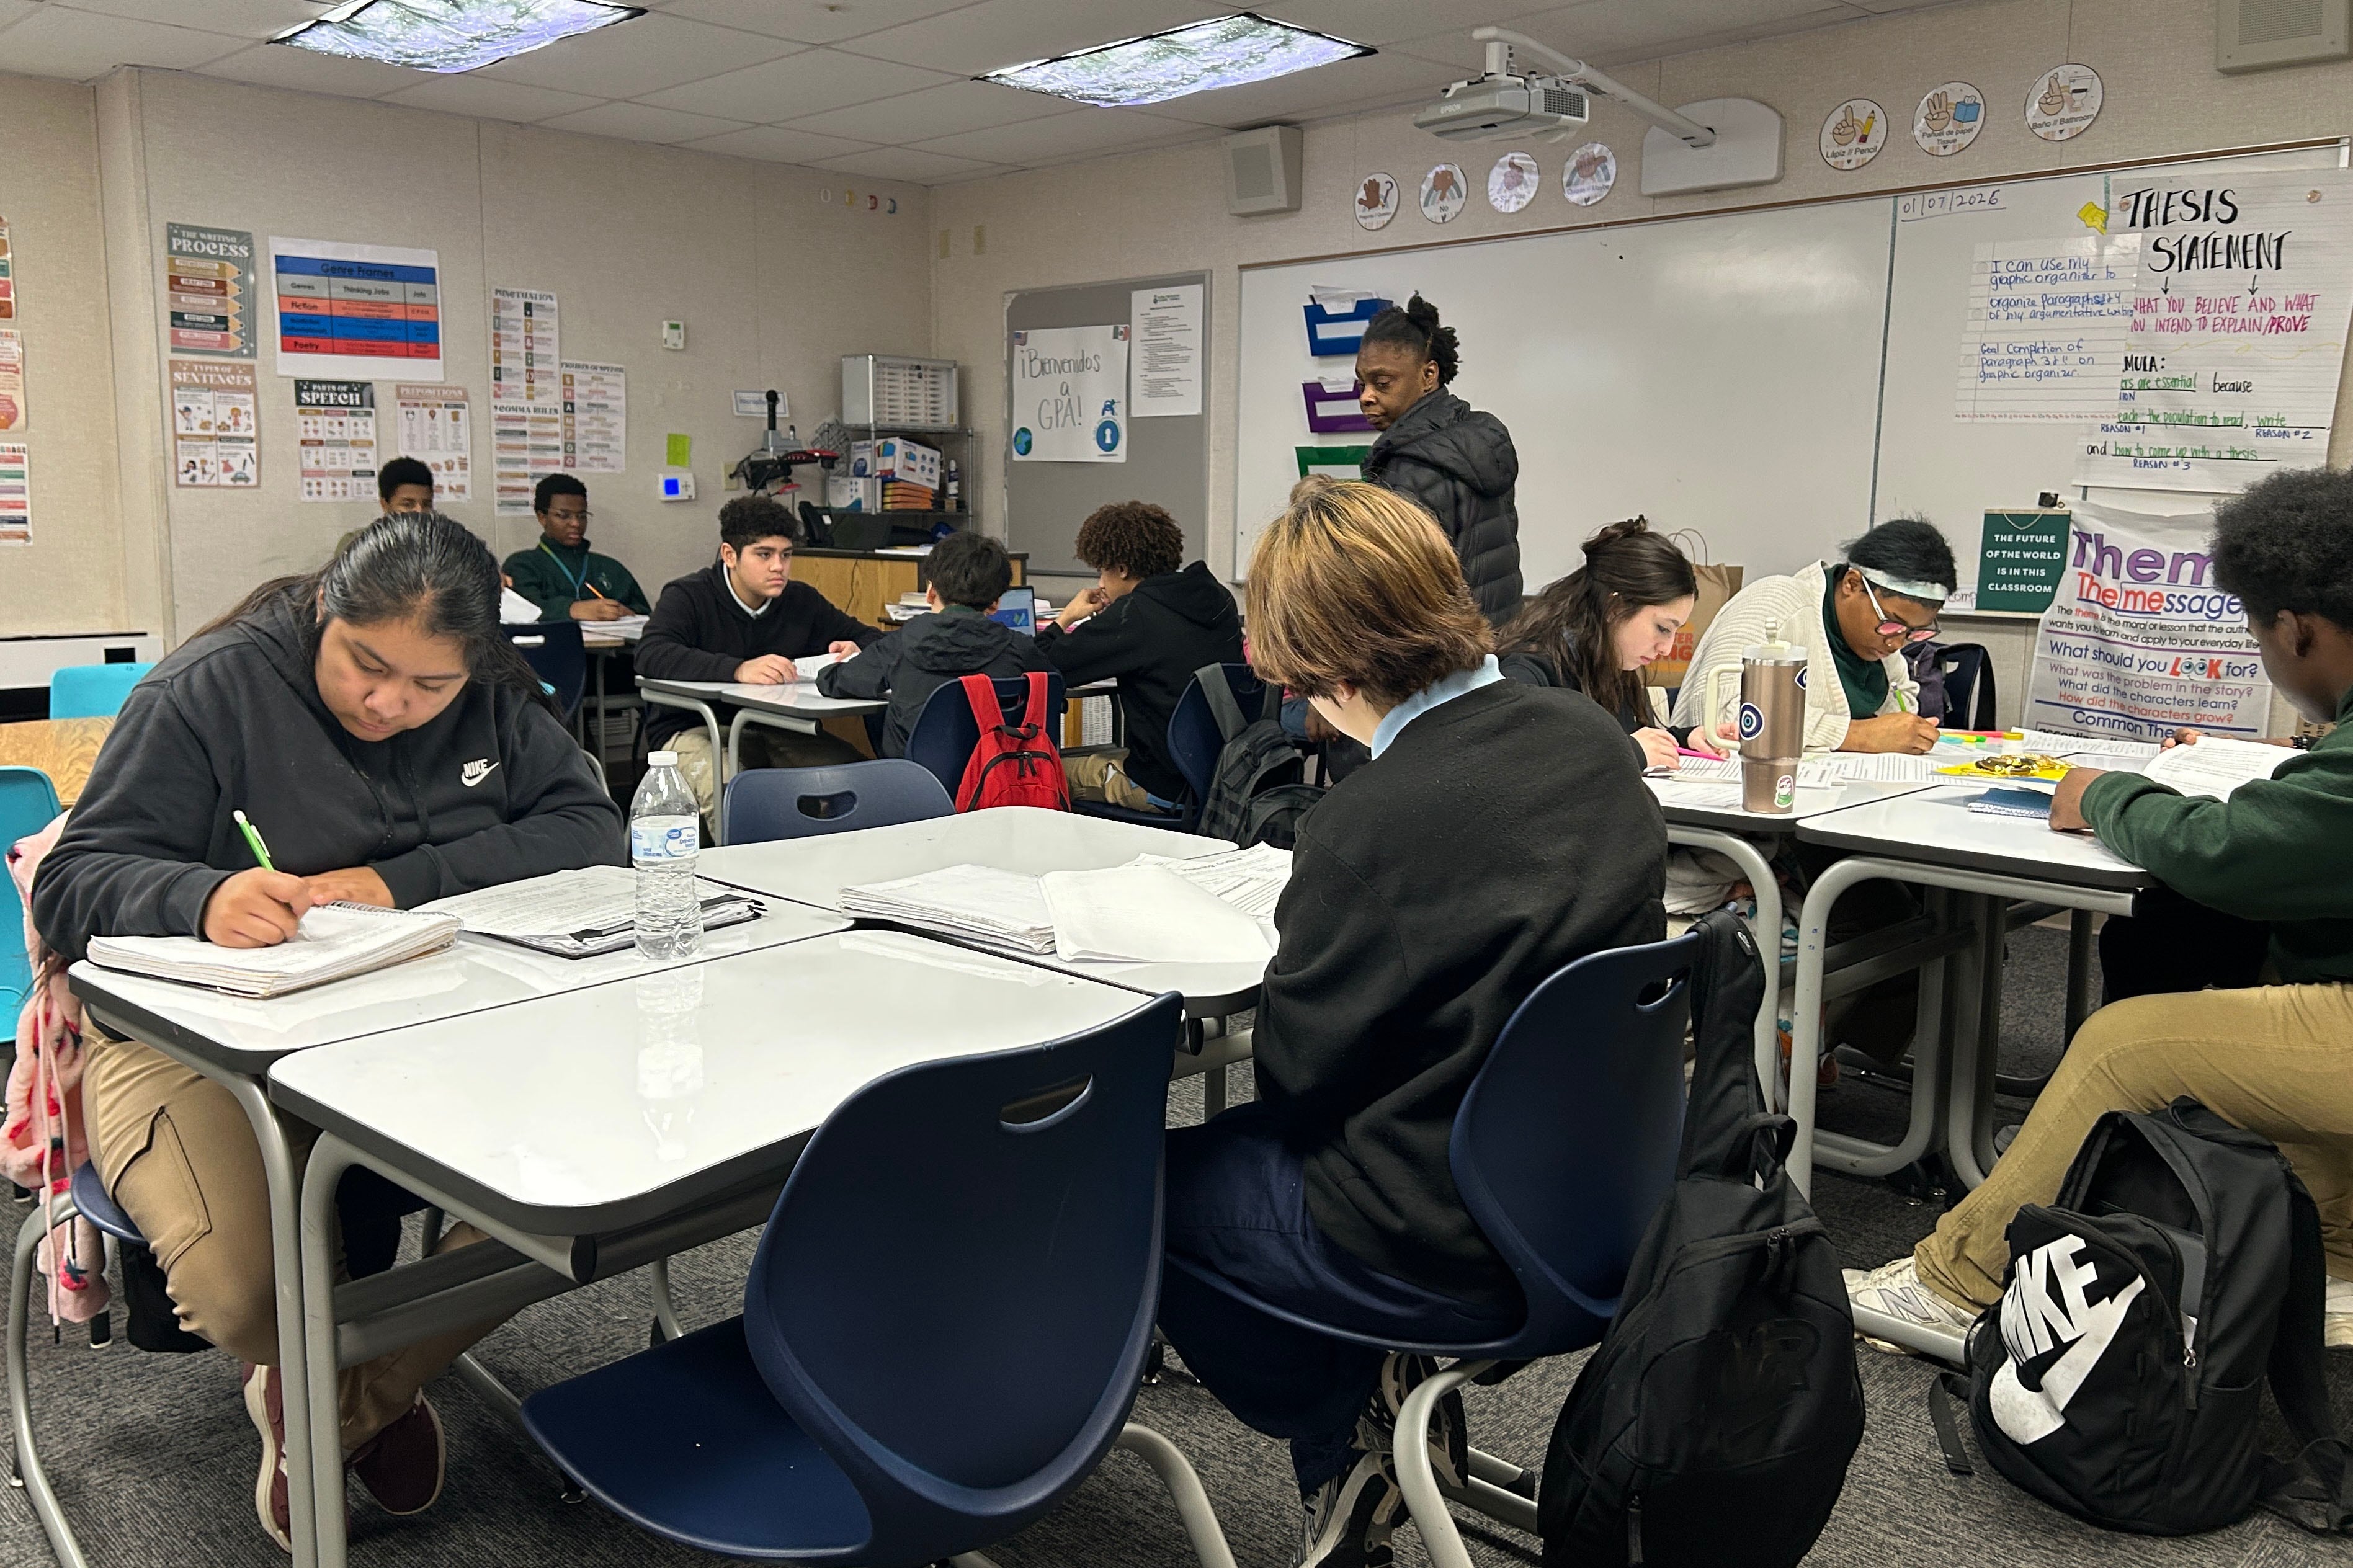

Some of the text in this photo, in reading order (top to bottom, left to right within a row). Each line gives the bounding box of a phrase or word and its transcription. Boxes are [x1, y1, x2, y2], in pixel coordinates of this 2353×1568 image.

[2060, 114, 2094, 125] Bathroom
[1854, 145, 1878, 155] Pencil
[2121, 187, 2239, 229] THESIS
[181, 230, 197, 239] THE
[171, 237, 249, 258] PROCESS
[2148, 230, 2292, 273] STATEMENT
[321, 263, 394, 279] Genre Frames
[1991, 261, 2001, 274] I
[1990, 265, 2116, 291] graphic organizer to
[290, 282, 390, 296] Genres Thinking Jobs
[291, 301, 318, 311] Fiction
[1990, 296, 2036, 310] organize
[2165, 296, 2185, 313] YOU
[2195, 295, 2241, 314] BELIEVE
[2249, 296, 2277, 313] AND
[2284, 293, 2321, 311] WHAT
[1989, 309, 2000, 320] of
[2155, 316, 2192, 335] INTEND
[2196, 316, 2207, 331] TO
[293, 341, 319, 351] Poetry
[2067, 338, 2084, 352] of
[2079, 355, 2095, 365] on
[2122, 354, 2166, 372] MULA:
[174, 372, 252, 386] SENTENCES
[1979, 370, 2020, 383] graphic
[2138, 372, 2253, 393] are essential because
[1060, 381, 1070, 397] a
[301, 392, 360, 406] SPEECH
[499, 406, 531, 414] COMMA
[1037, 396, 1083, 429] GPA!
[2117, 408, 2138, 422] each
[2148, 408, 2160, 422] the
[2163, 410, 2203, 429] population
[2210, 412, 2220, 425] to
[2257, 412, 2287, 427] write
[2101, 423, 2131, 434] REASON
[2256, 428, 2290, 439] REASON
[2087, 440, 2107, 457] and
[2115, 441, 2132, 456] how
[2135, 442, 2144, 457] to
[2149, 446, 2171, 457] come
[2176, 446, 2186, 461] up
[2190, 444, 2210, 458] with
[2226, 445, 2258, 460] thesis
[2133, 458, 2168, 469] REASON
[2016, 535, 2056, 543] FUTURE
[1986, 550, 2061, 559] OF THE WORLD
[2072, 529, 2215, 586] Them
[1997, 568, 2046, 577] IS IN THIS
[1988, 583, 2052, 593] CLASSROOM
[2057, 605, 2248, 635] The theme is the moral or lesson that the auth
[2050, 620, 2073, 630] wants
[2075, 624, 2091, 635] you
[2120, 633, 2140, 643] and
[2141, 635, 2167, 646] apply
[2168, 636, 2177, 645] to
[2179, 638, 2200, 648] your
[2200, 639, 2244, 650] everyday
[2050, 640, 2089, 659] What
[2092, 647, 2135, 669] should
[2138, 658, 2168, 673] you
[2226, 661, 2259, 678] for?
[2050, 662, 2254, 699] What was the problem in the story?
[2058, 677, 2088, 692] What
[2091, 682, 2110, 695] did
[2113, 686, 2128, 699] the
[2129, 692, 2194, 708] characters
[2058, 690, 2234, 724] How did the characters grow?
[2073, 710, 2174, 739] Common The
[463, 757, 488, 778] NIKE
